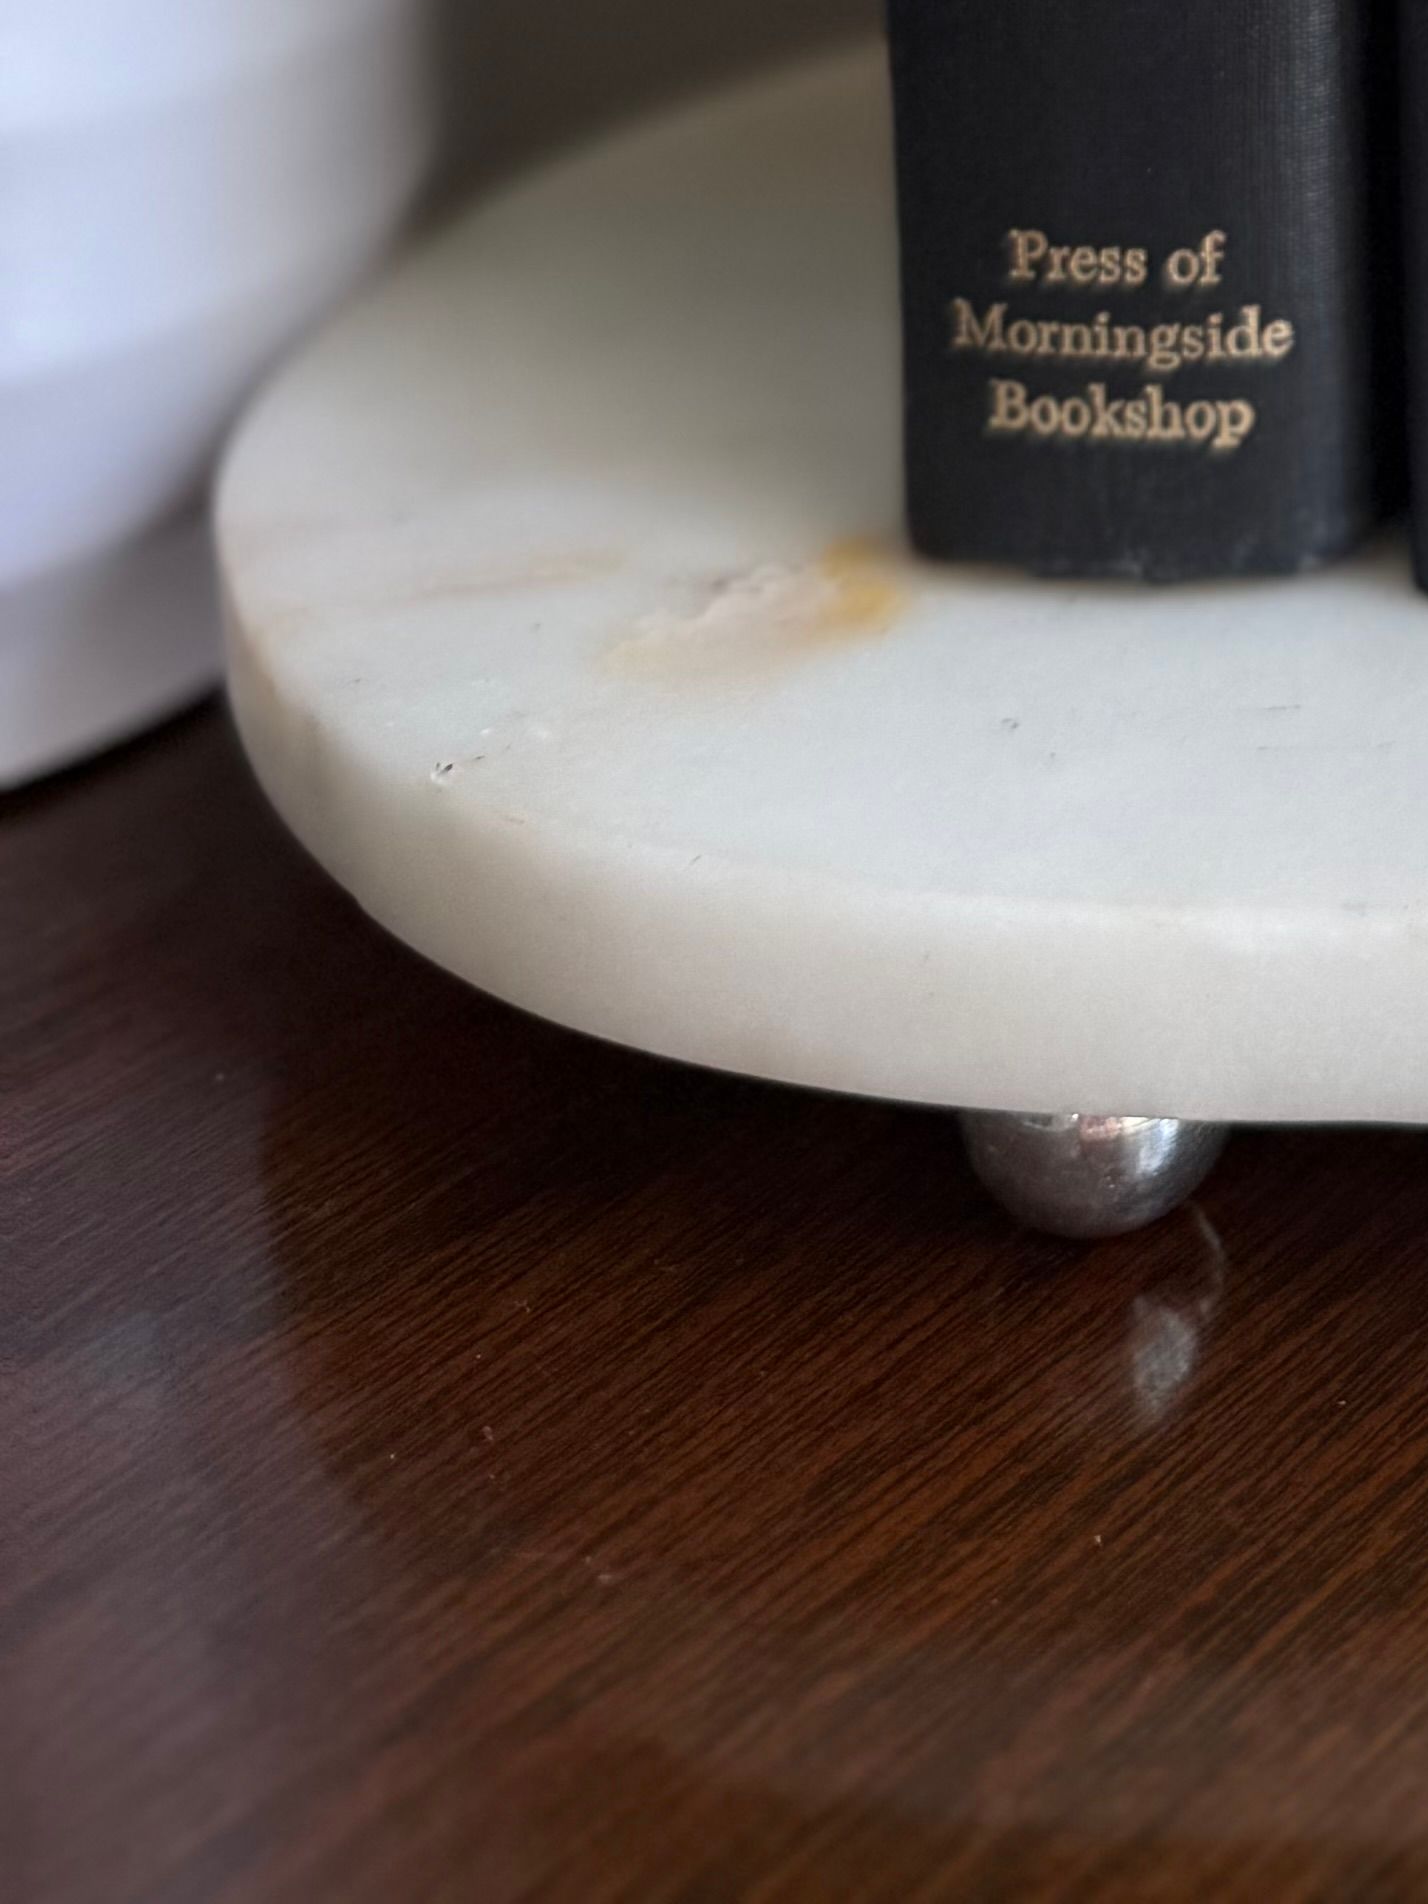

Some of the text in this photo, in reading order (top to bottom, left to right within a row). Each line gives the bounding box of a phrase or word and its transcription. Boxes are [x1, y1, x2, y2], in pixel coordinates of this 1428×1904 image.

[1008, 228, 1225, 285] Press of
[951, 297, 1296, 371] Morningside
[988, 379, 1256, 450] Bookshop
